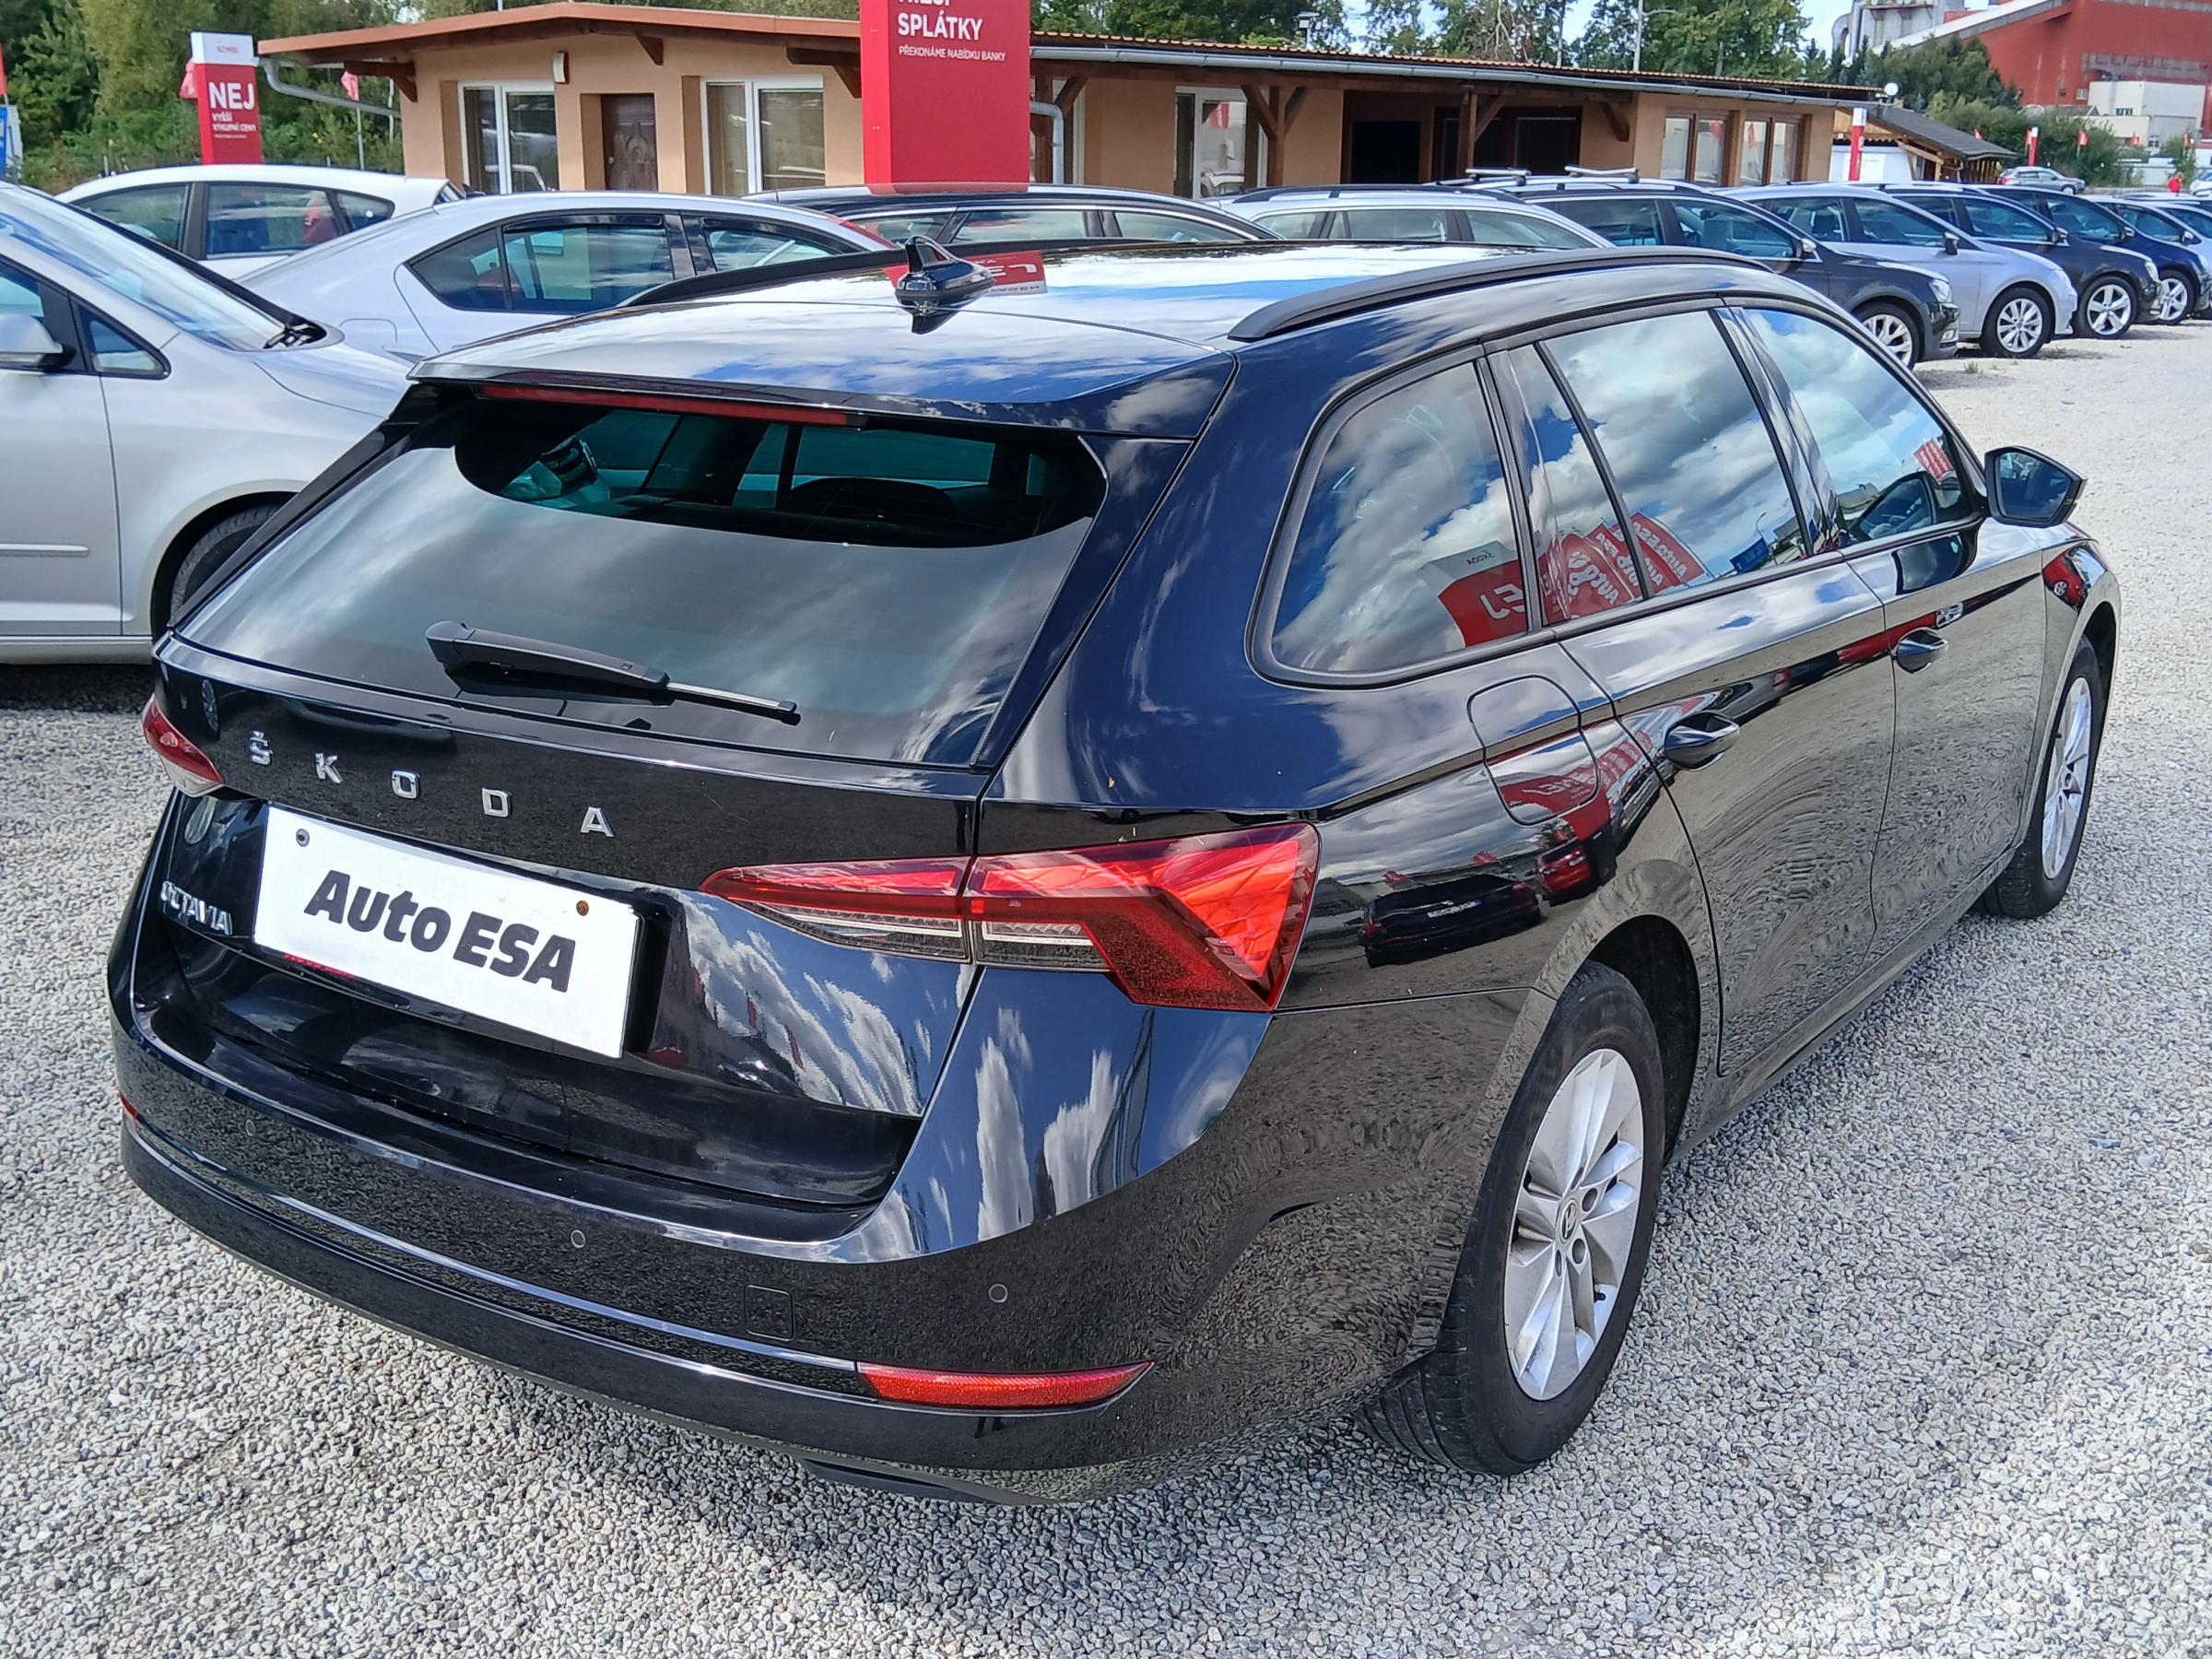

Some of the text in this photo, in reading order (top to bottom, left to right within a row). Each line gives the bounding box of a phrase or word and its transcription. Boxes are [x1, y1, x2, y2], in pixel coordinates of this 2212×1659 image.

[898, 10, 982, 41] SPLÁTKY
[899, 44, 1006, 61] PŘEKONÁME NABÍDKU BANKY
[208, 81, 255, 110] NEJ
[250, 730, 615, 838] ŠKODA
[160, 880, 234, 935] OCTAVIA
[303, 869, 576, 993] Auto ESA
